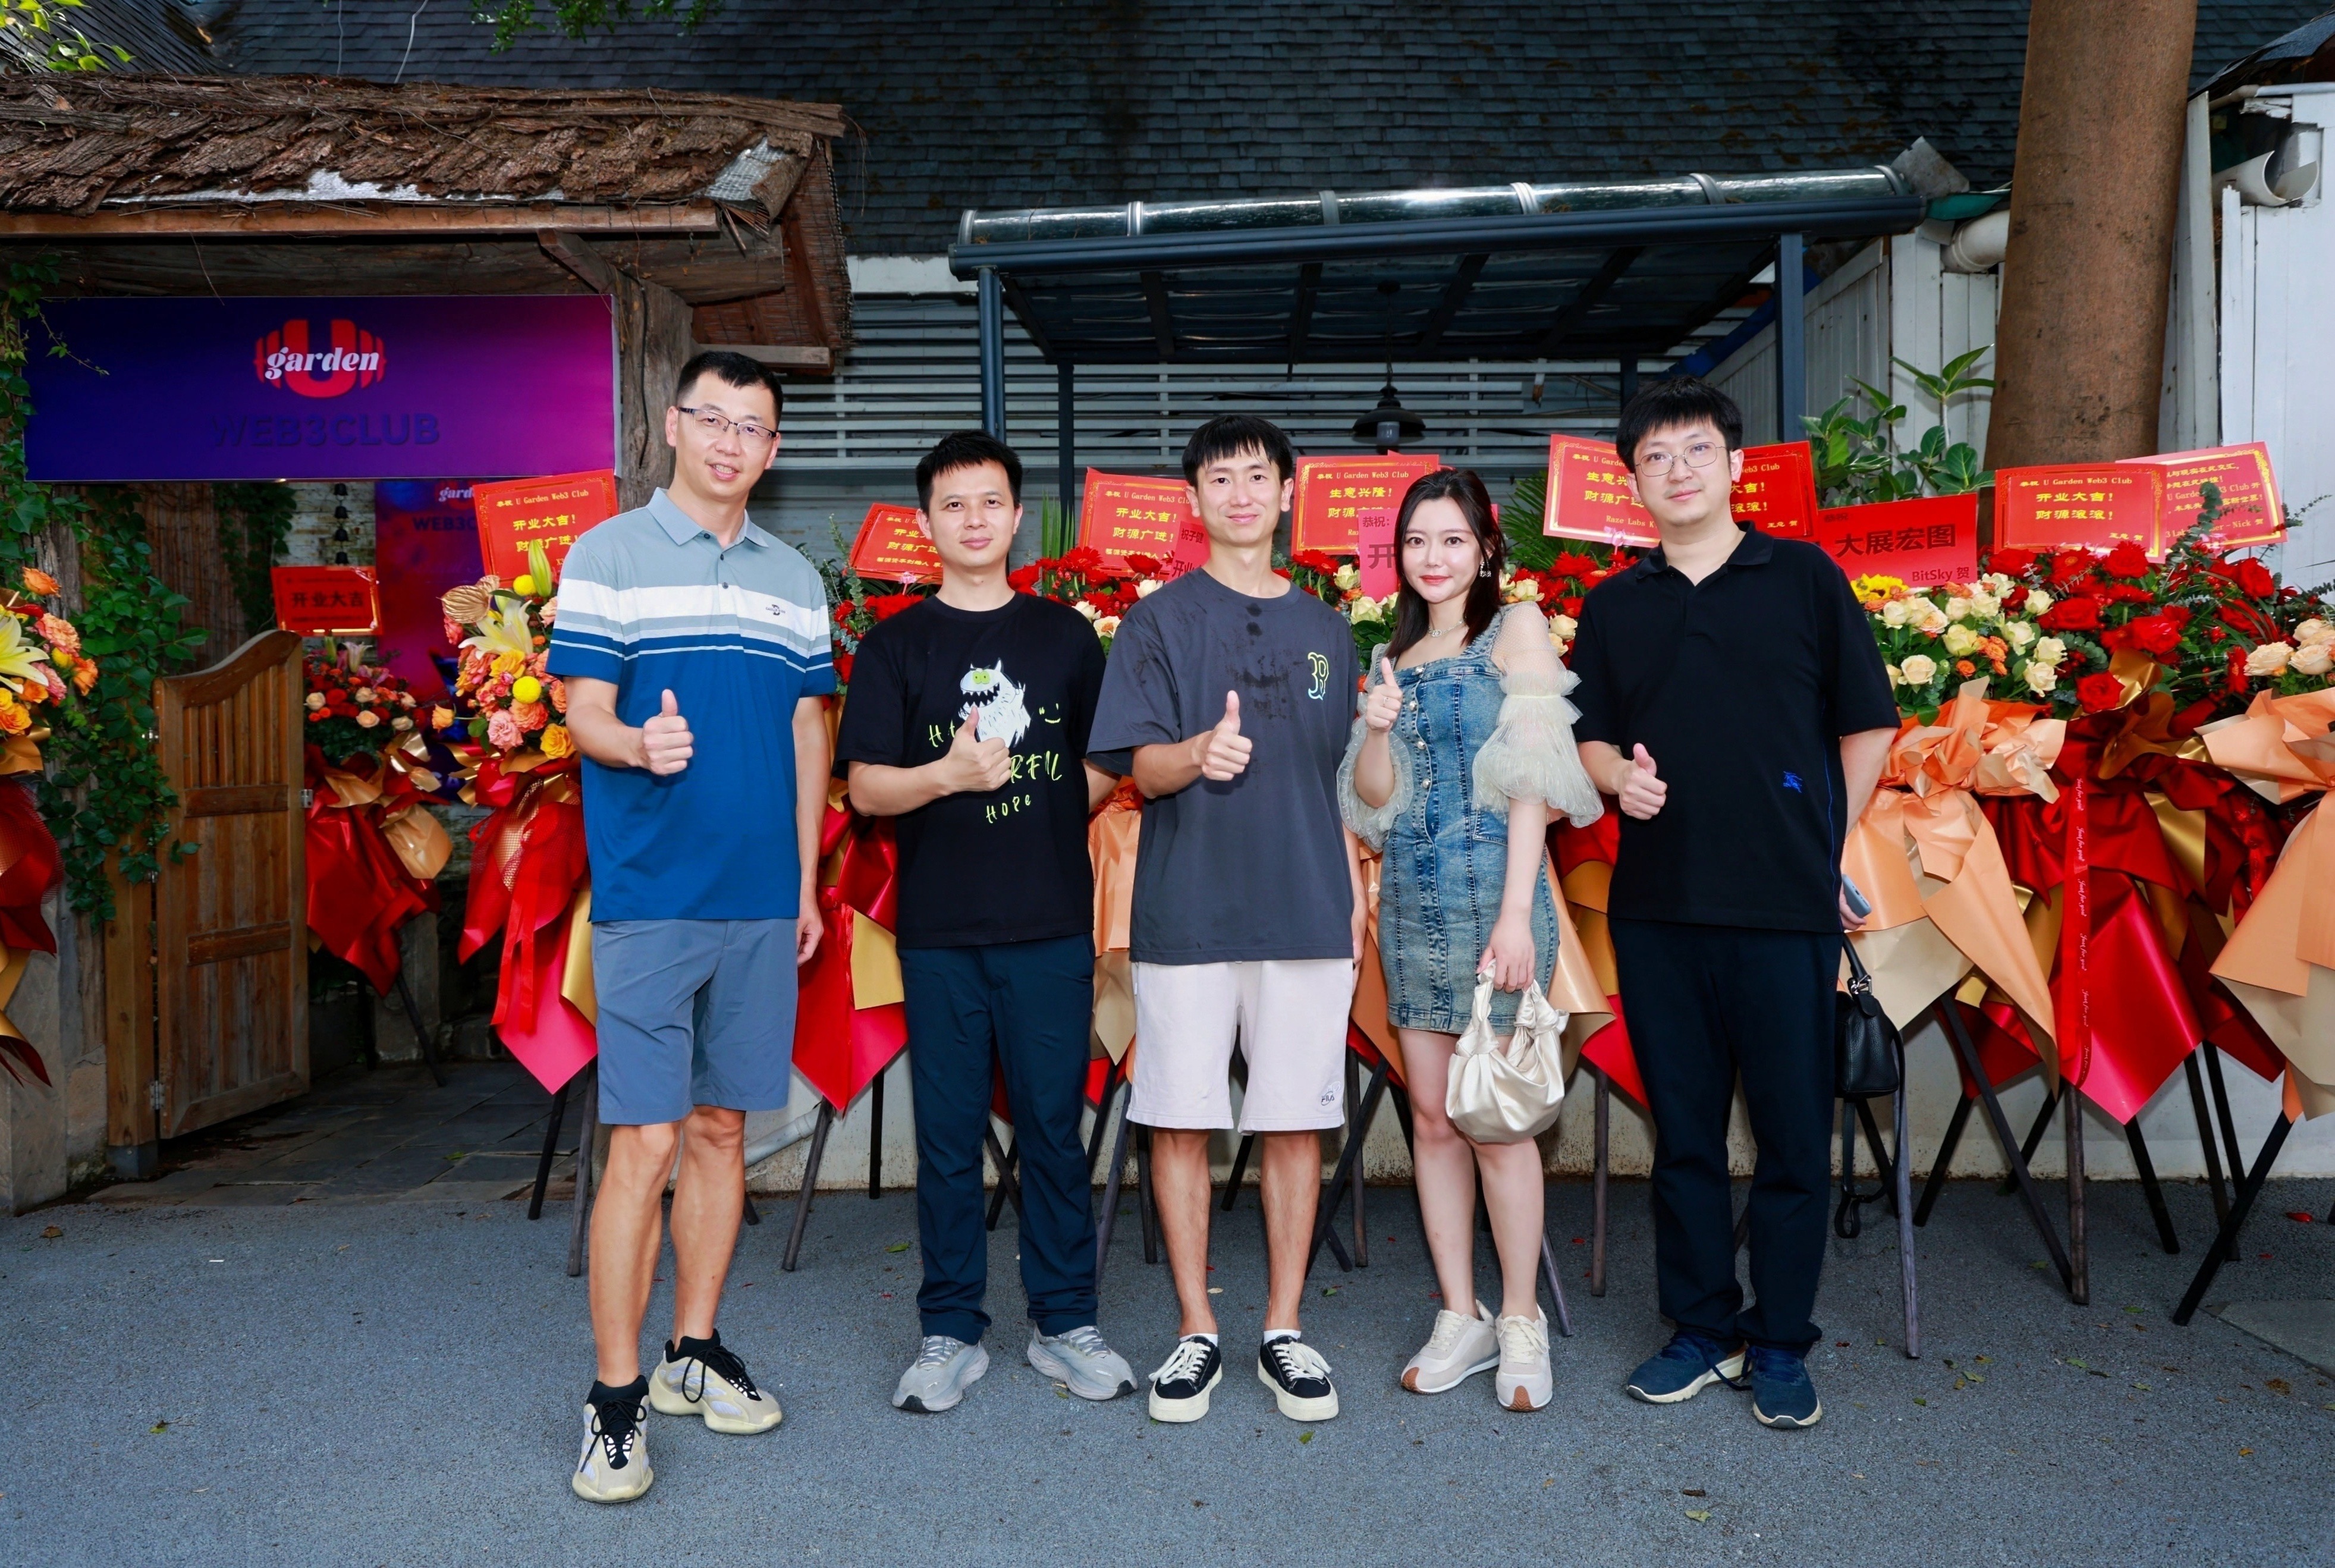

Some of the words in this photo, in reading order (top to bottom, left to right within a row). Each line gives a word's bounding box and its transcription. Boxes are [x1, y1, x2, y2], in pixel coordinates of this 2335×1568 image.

[265, 347, 380, 379] garden
[211, 413, 439, 446] WEB3CLUB
[1572, 453, 1590, 461] 恭祝
[1601, 459, 1626, 467] Garde
[1761, 463, 1780, 472] Club
[438, 487, 473, 502] gard
[523, 495, 549, 504] Garden
[551, 492, 568, 500] Web3
[1131, 492, 1155, 501] Garden
[1158, 495, 1175, 503] Web3
[1329, 486, 1393, 499] 生意兴隆!
[2035, 492, 2113, 502] 开业大吉!
[2175, 489, 2201, 500] Garde
[2229, 482, 2249, 492] Club
[1115, 507, 1177, 523] 开业大吉!
[1362, 516, 1390, 528] 恭祝:
[1605, 515, 1624, 524] Raze
[1627, 518, 1646, 527] Labs
[1649, 520, 1657, 529] K
[2035, 509, 2113, 520] 财源滚滚!
[413, 516, 476, 531] WEB3C
[513, 514, 576, 531] 开业大吉!
[2232, 521, 2251, 529] Nick
[894, 529, 926, 538] 开业
[1112, 527, 1174, 543] 财源广进!
[1181, 528, 1204, 543] 祝子健
[1834, 523, 1956, 558] 大展宏图
[516, 535, 578, 552] 财广进!
[1912, 569, 1953, 582] BitSky
[1956, 567, 1970, 580] 贺
